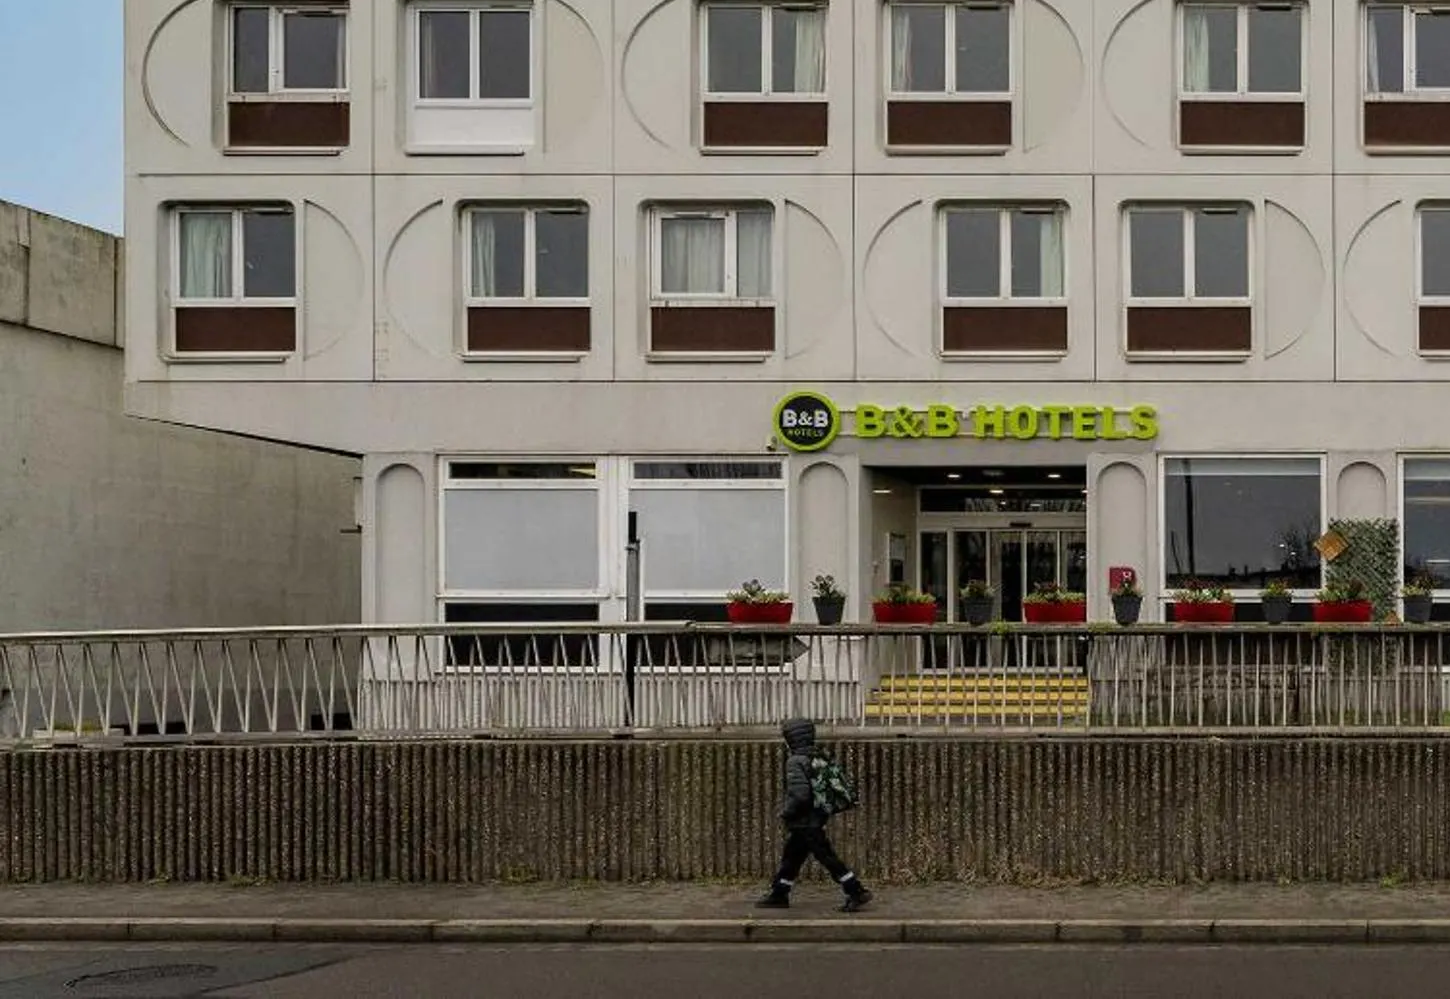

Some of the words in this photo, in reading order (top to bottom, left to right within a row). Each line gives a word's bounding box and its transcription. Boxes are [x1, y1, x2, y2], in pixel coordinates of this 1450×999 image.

[782, 408, 828, 428] B&B
[856, 404, 959, 438] B&B
[974, 404, 1159, 440] HOTELS
